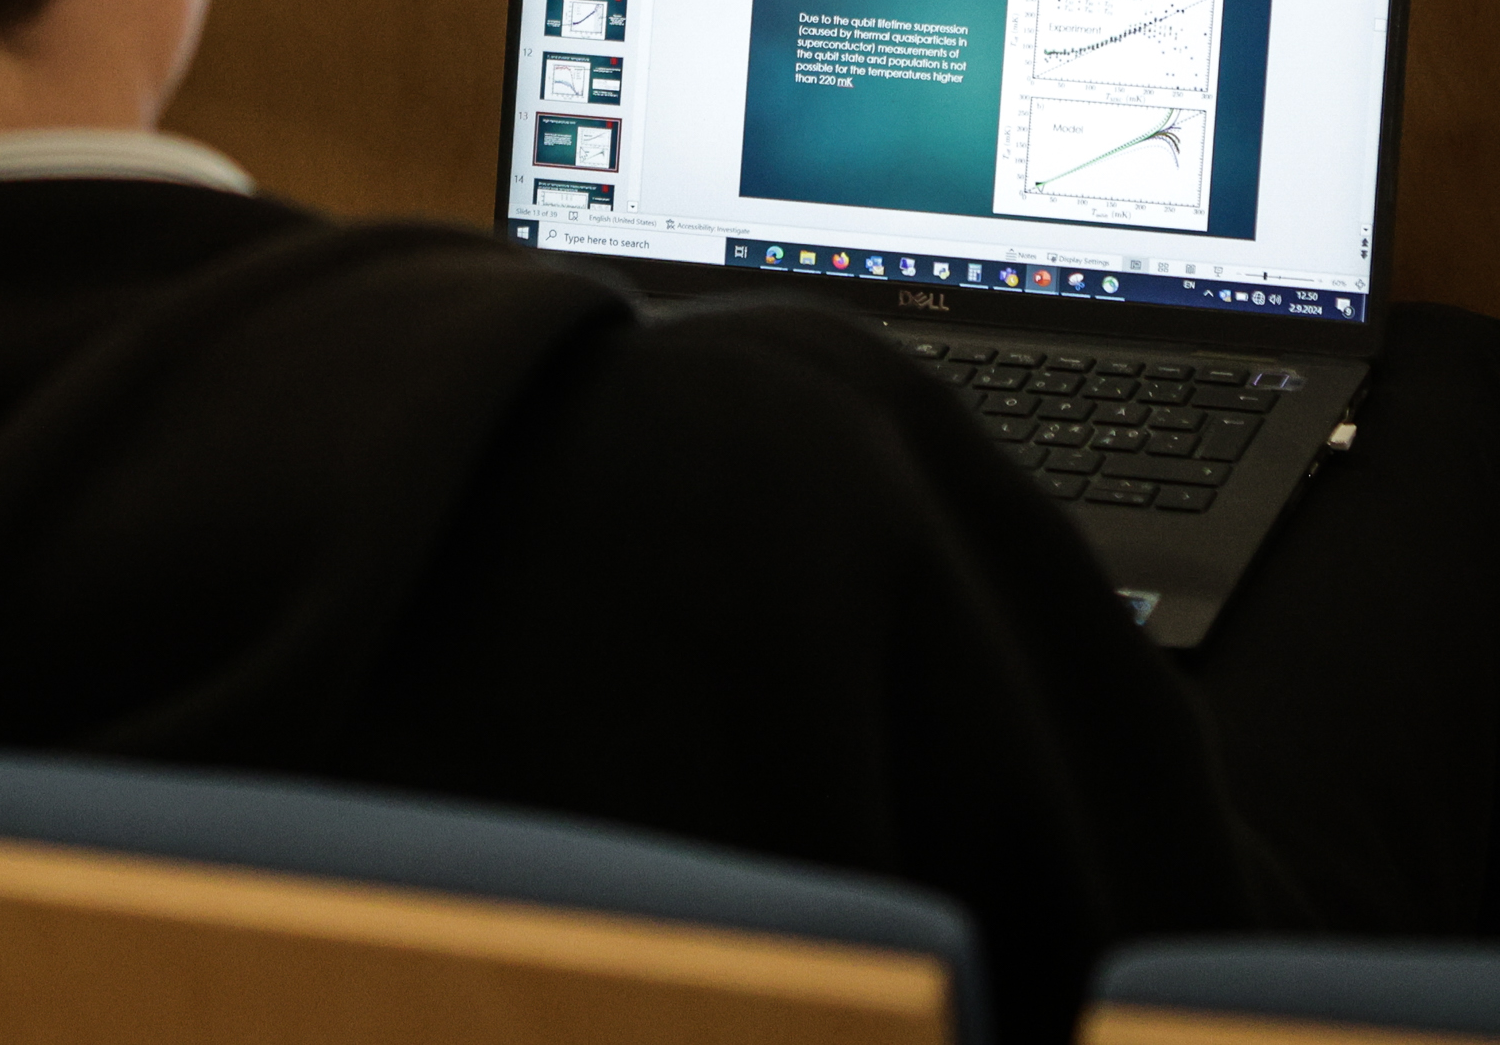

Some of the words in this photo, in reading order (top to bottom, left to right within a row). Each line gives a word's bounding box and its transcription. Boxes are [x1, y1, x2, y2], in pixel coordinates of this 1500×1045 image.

[800, 13, 819, 24] Due
[821, 15, 831, 24] to
[833, 15, 849, 26] the
[851, 17, 876, 30] qubit
[878, 19, 911, 31] lifetime
[914, 23, 968, 36] suppression
[1049, 22, 1102, 35] Experiment
[799, 27, 838, 38] (caused
[840, 29, 852, 40] by
[854, 30, 890, 41] thermal
[892, 33, 957, 47] quasiparticles
[959, 37, 967, 47] in
[797, 39, 876, 54] superconductor)
[878, 45, 947, 58] measurements
[949, 49, 959, 59] of
[797, 49, 813, 59] the
[814, 51, 839, 63] qubit
[841, 53, 865, 64] state
[866, 55, 886, 66] and
[888, 57, 940, 71] population
[950, 61, 967, 71] not
[796, 62, 833, 74] possible
[835, 64, 848, 74] for
[850, 65, 866, 76] the
[868, 67, 931, 81] temperatures
[933, 71, 964, 84] higher
[796, 73, 817, 84] than
[819, 75, 836, 86] 220
[838, 77, 854, 87] mK
[1053, 123, 1084, 135] Model
[589, 215, 611, 224] English
[636, 218, 657, 228] States)
[565, 233, 585, 245] Type
[588, 236, 607, 246] here
[610, 239, 618, 247] to
[621, 239, 650, 250] search
[1084, 257, 1110, 267] Settings
[1183, 281, 1196, 289] EN
[900, 290, 950, 311] DELL
[1289, 303, 1322, 315] 2.9.2024
